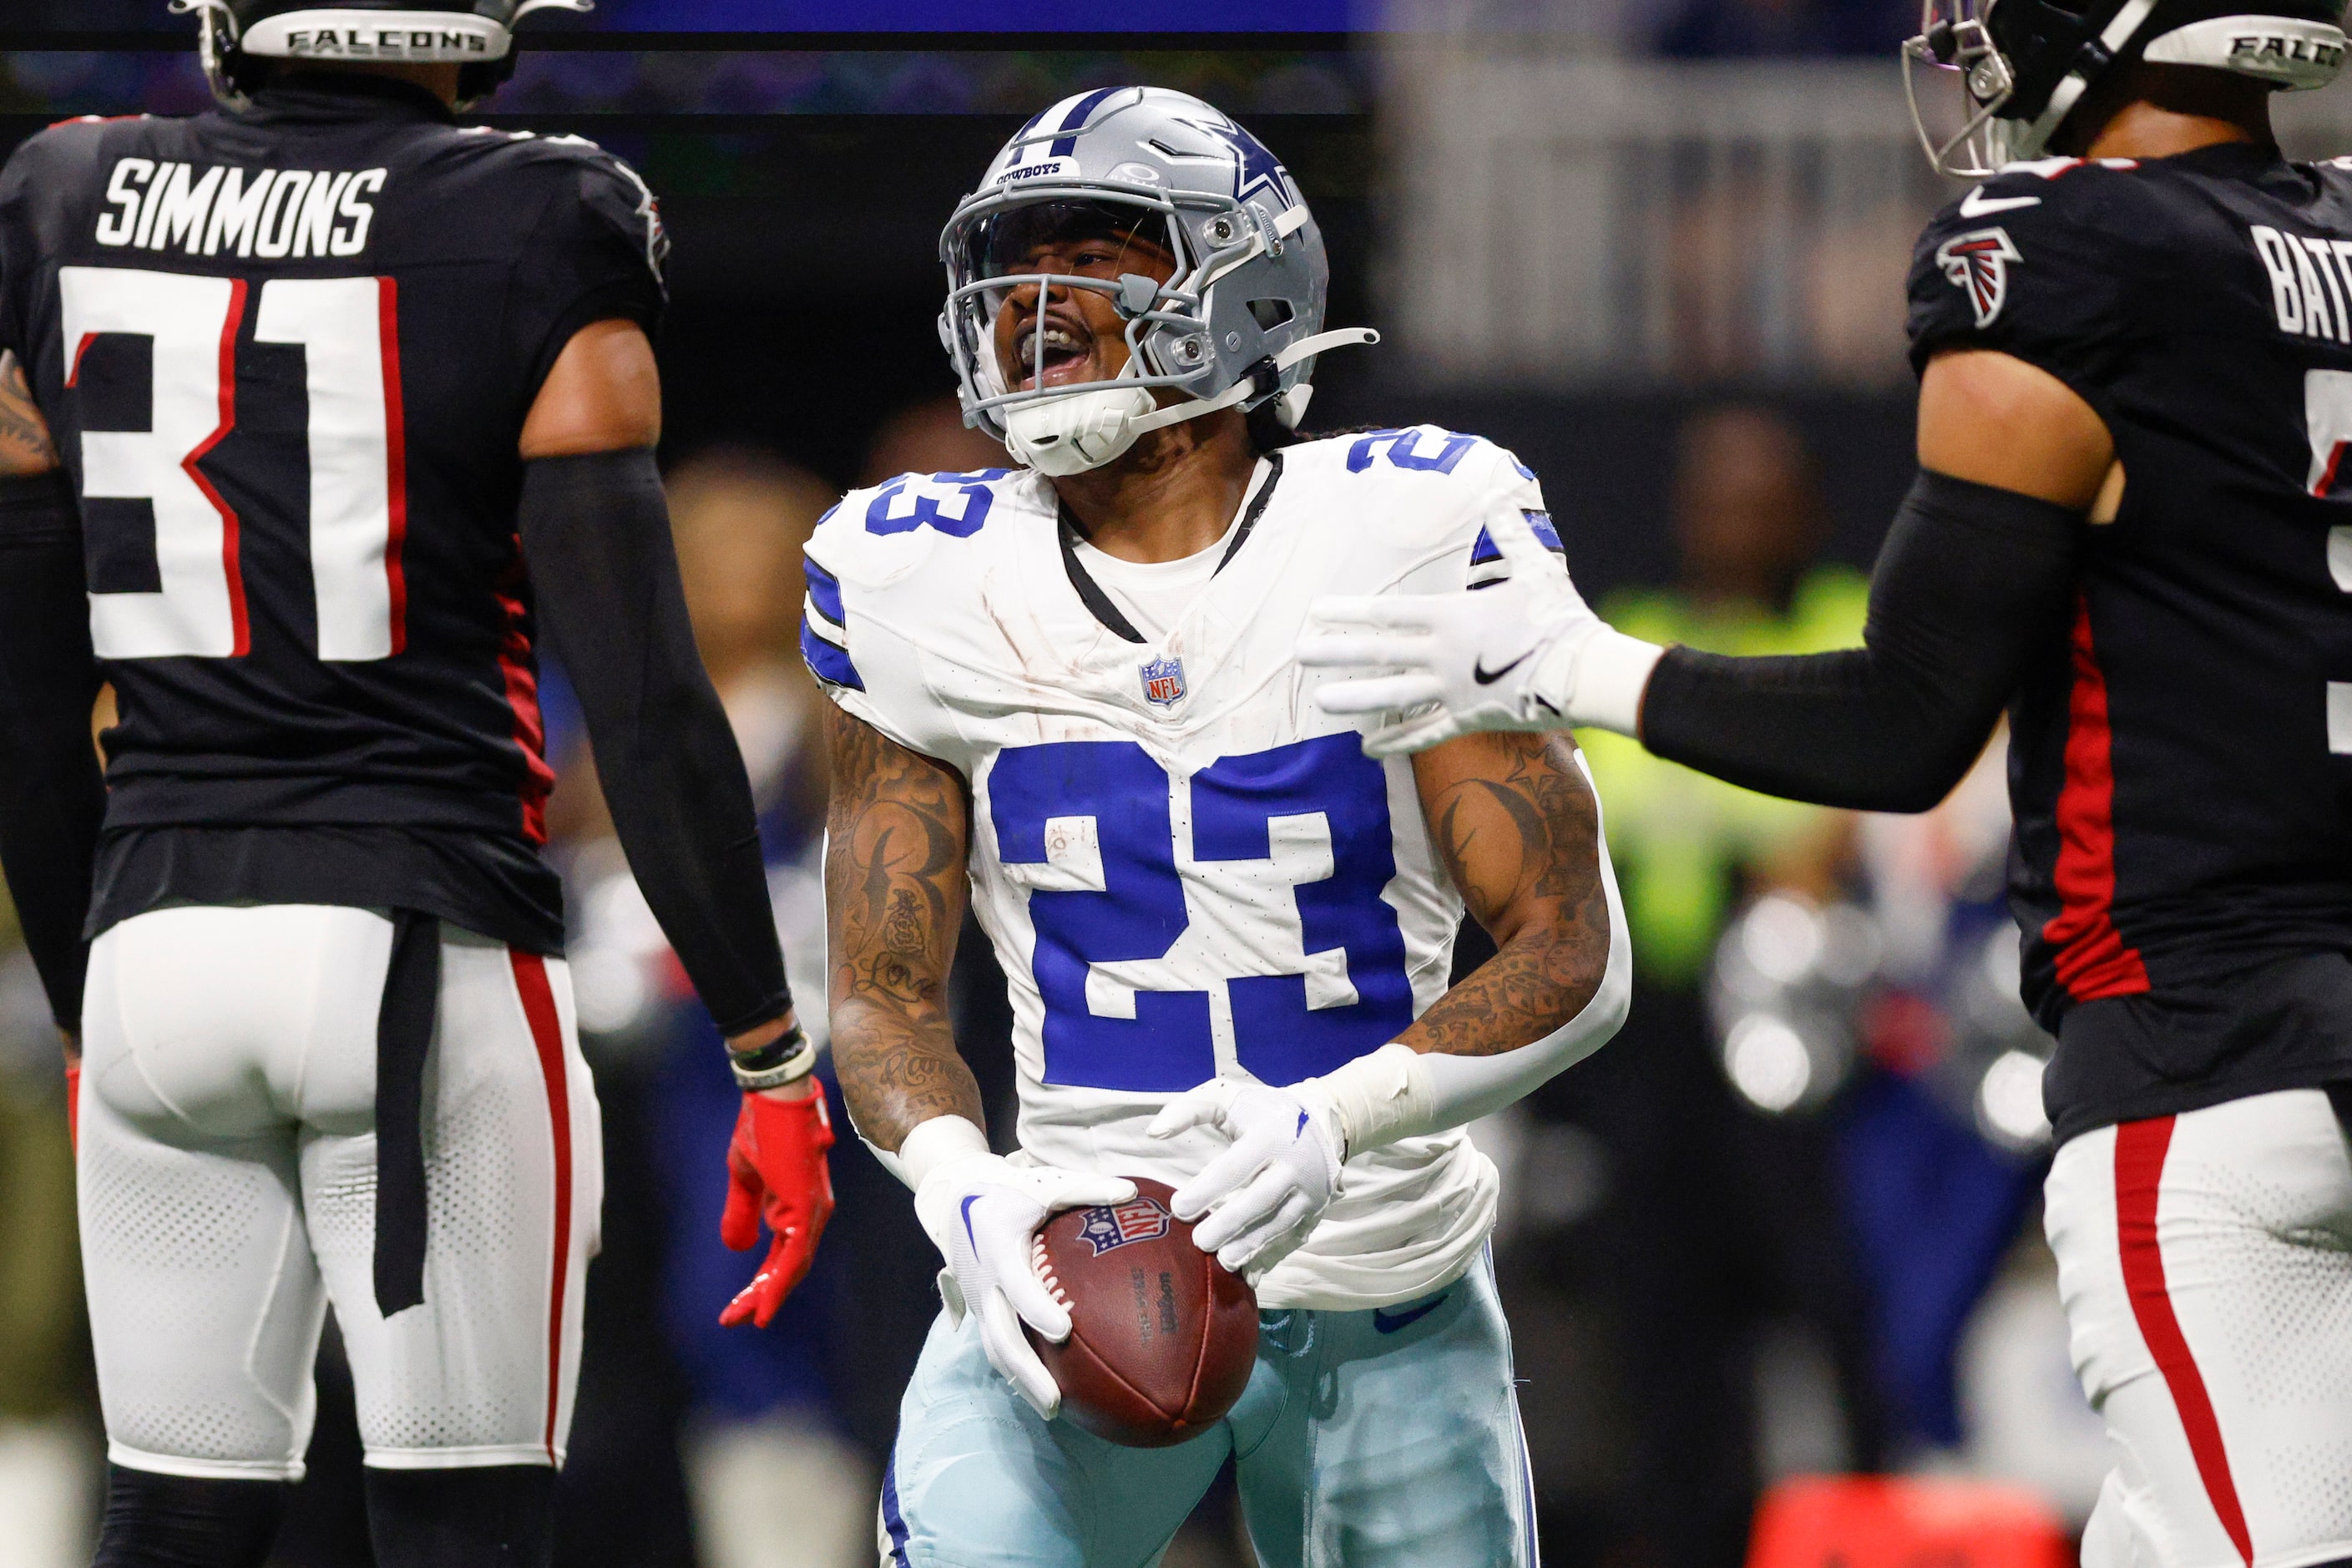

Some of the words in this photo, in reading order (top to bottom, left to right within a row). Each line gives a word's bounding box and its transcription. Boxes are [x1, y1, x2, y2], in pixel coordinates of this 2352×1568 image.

[287, 30, 486, 53] FALCONS
[997, 162, 1061, 185] COWBOYS
[96, 158, 387, 258] SIMMONS
[58, 266, 405, 662] 31
[1148, 677, 1181, 699] NFL
[988, 730, 1414, 1093] 23
[1116, 1201, 1161, 1238] NFL
